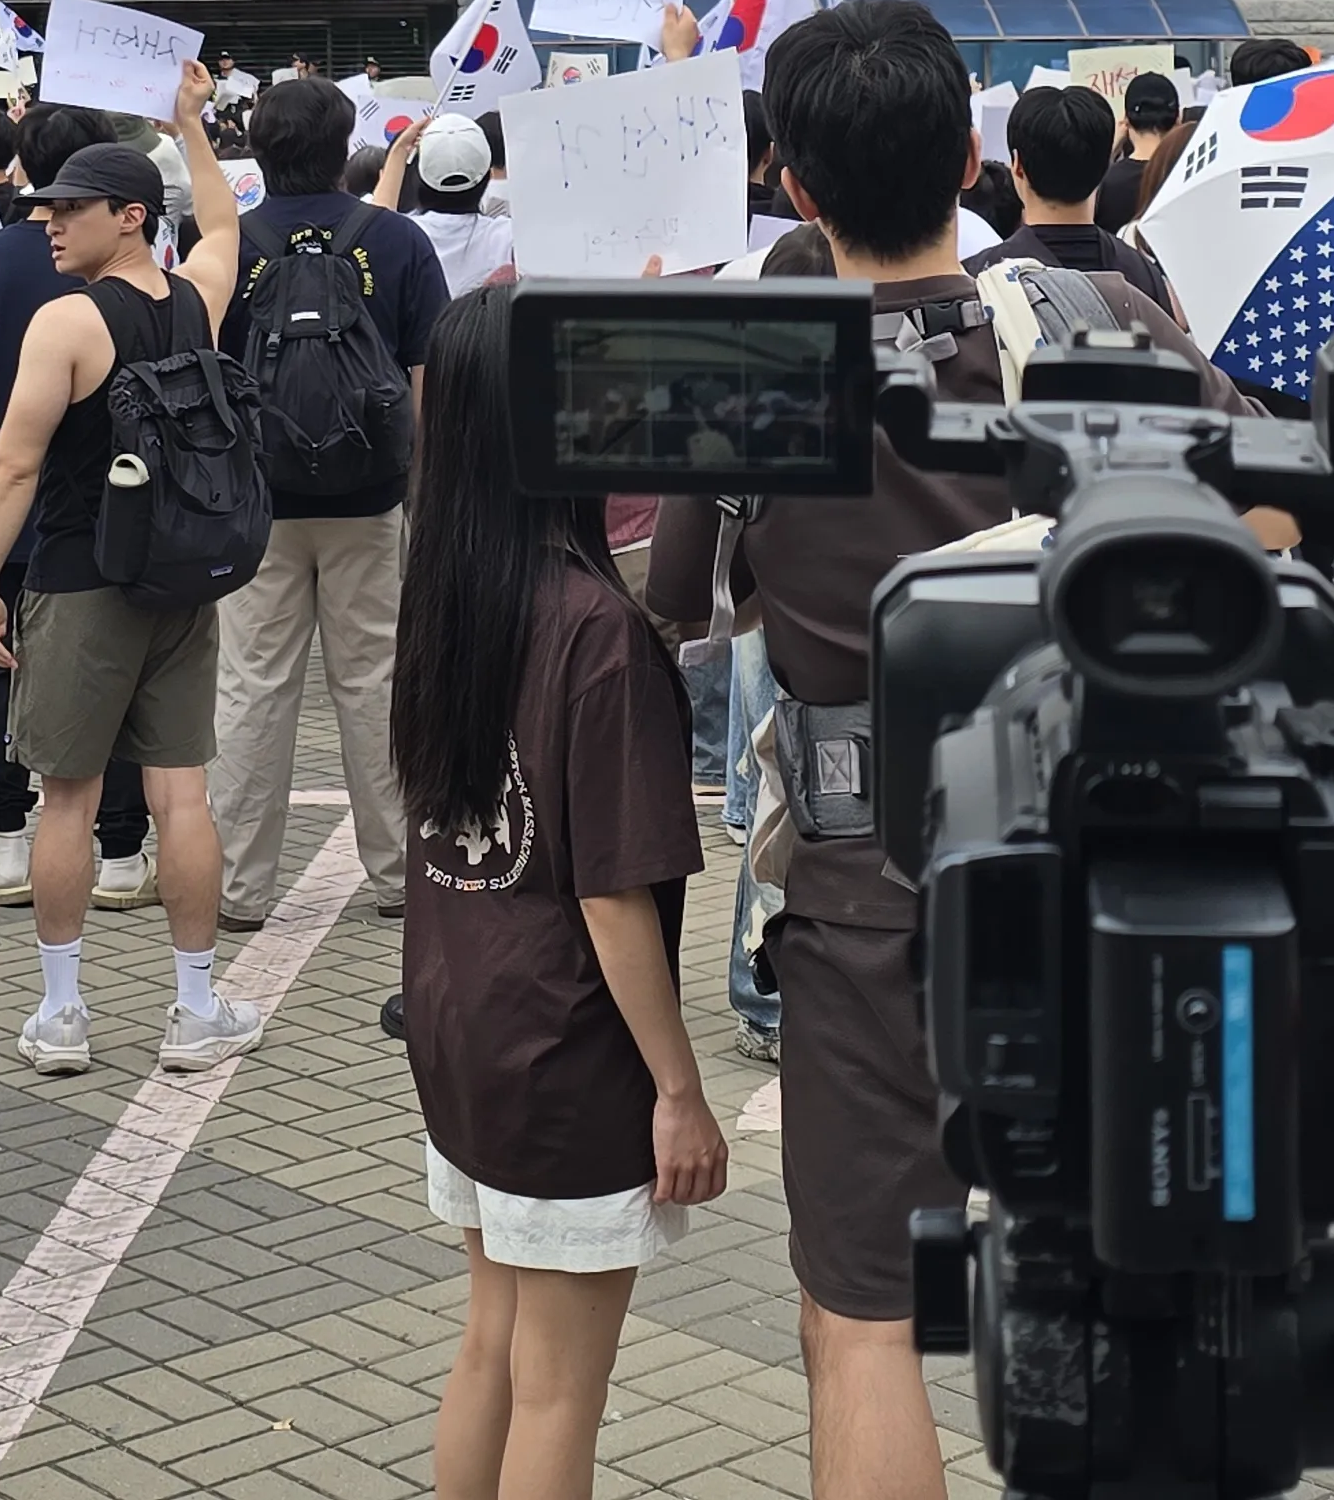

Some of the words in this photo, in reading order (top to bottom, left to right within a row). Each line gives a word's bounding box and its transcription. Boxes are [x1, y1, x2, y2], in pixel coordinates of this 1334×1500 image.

[1084, 66, 1139, 98] 재선
[490, 794, 536, 890] MASSACHUSETTS
[425, 861, 453, 889] USA
